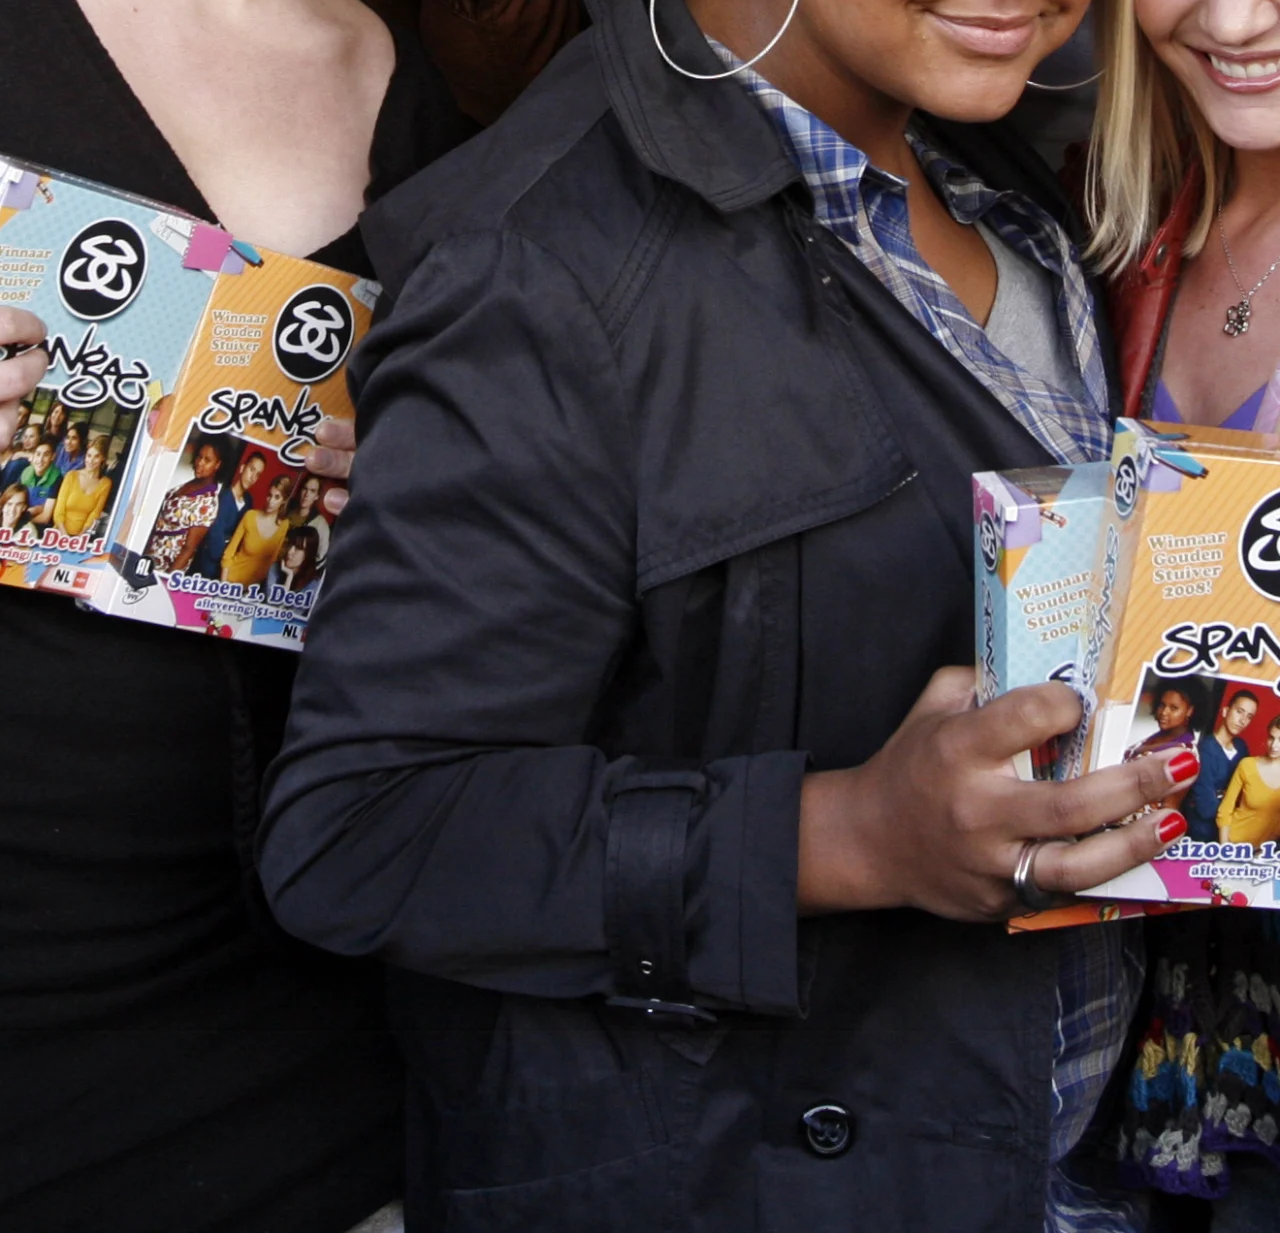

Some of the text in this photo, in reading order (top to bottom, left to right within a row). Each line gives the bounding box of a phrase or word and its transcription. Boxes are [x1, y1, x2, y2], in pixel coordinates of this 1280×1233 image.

[212, 310, 268, 325] Winnaar
[213, 325, 262, 338] Gouden
[210, 339, 259, 352] Stuiver
[216, 354, 251, 366] 2008!
[42, 531, 90, 551] Deel
[1148, 532, 1227, 551] Winnaar
[33, 554, 60, 565] 1-50
[1153, 548, 1223, 566] Gouden
[53, 568, 70, 583] NL
[136, 560, 150, 575] AL
[1153, 565, 1222, 584] Stuiver
[168, 572, 242, 598] Seizoen
[270, 589, 313, 609] Deel
[1015, 571, 1091, 601] Winnaar
[1164, 581, 1212, 599] 2008!
[195, 598, 294, 621] aflevering: 51-100
[1023, 588, 1090, 615] Gouden
[282, 624, 298, 639] NL
[1154, 838, 1252, 861] eizoen
[1190, 865, 1272, 880] aflevering:
